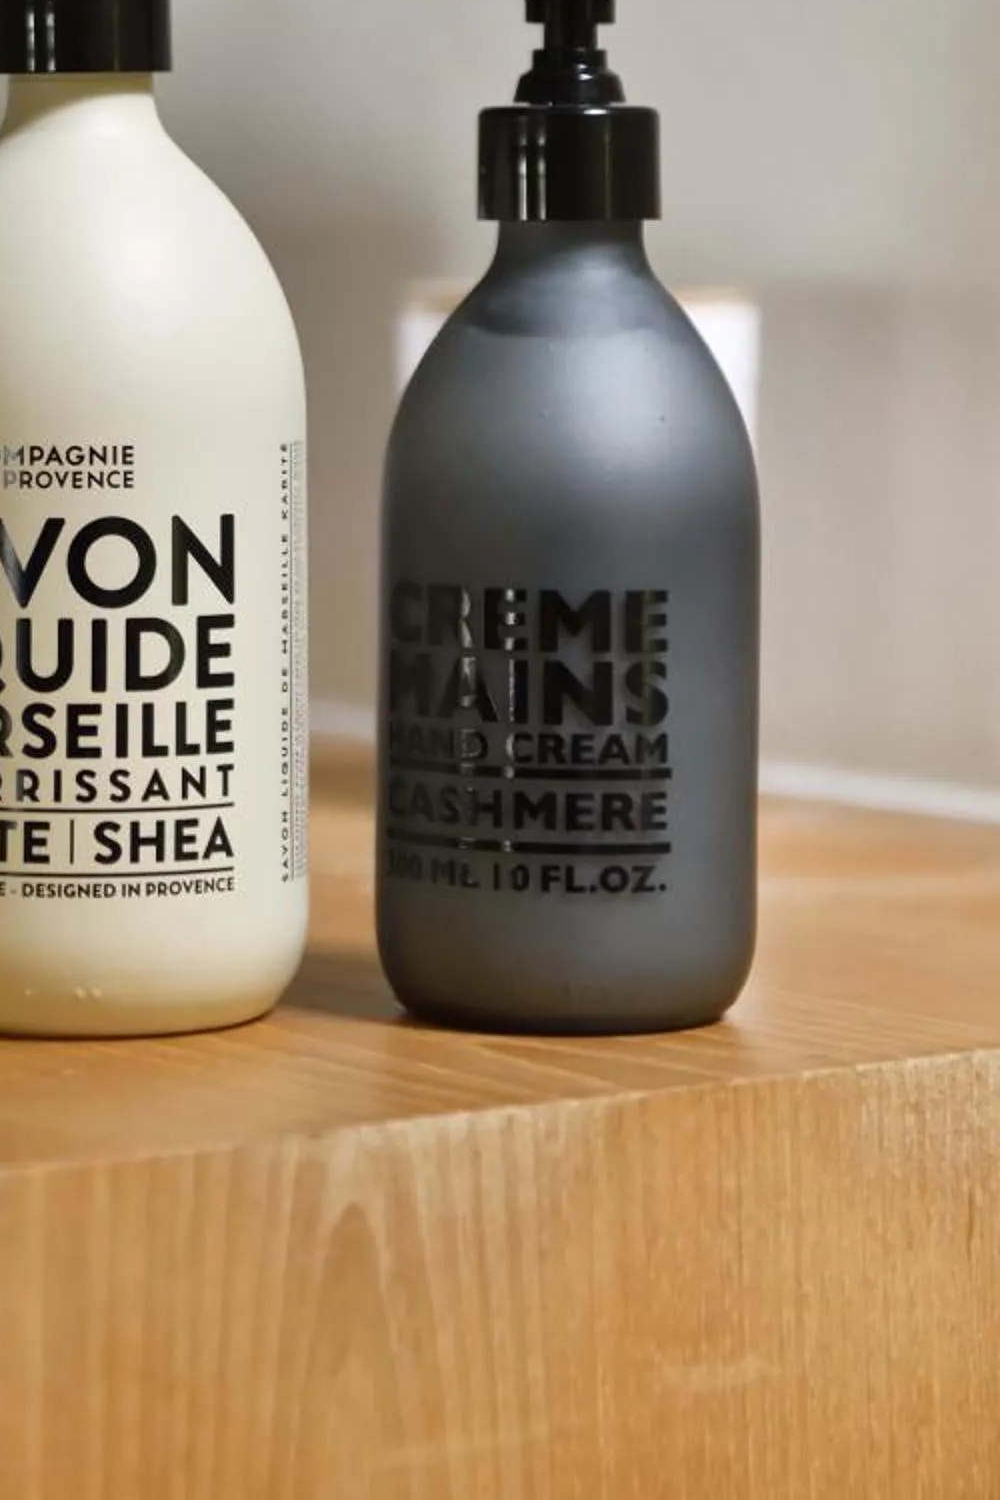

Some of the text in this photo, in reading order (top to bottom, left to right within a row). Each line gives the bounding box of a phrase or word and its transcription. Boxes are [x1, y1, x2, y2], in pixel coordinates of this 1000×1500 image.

[3, 470, 134, 489] PROVENCE
[280, 534, 289, 654] MARSEILLE
[391, 580, 669, 654] CREME
[281, 667, 289, 693] DE
[390, 650, 670, 727] MAINS
[281, 707, 289, 798] LIQUIDE
[505, 732, 669, 766] CREAM
[388, 776, 668, 832] CASHMERE
[94, 816, 235, 865] SHEA
[281, 810, 289, 883] SAVON
[22, 882, 117, 899] DESIGNED
[121, 882, 141, 898] IN
[146, 876, 235, 897] PROVENCE
